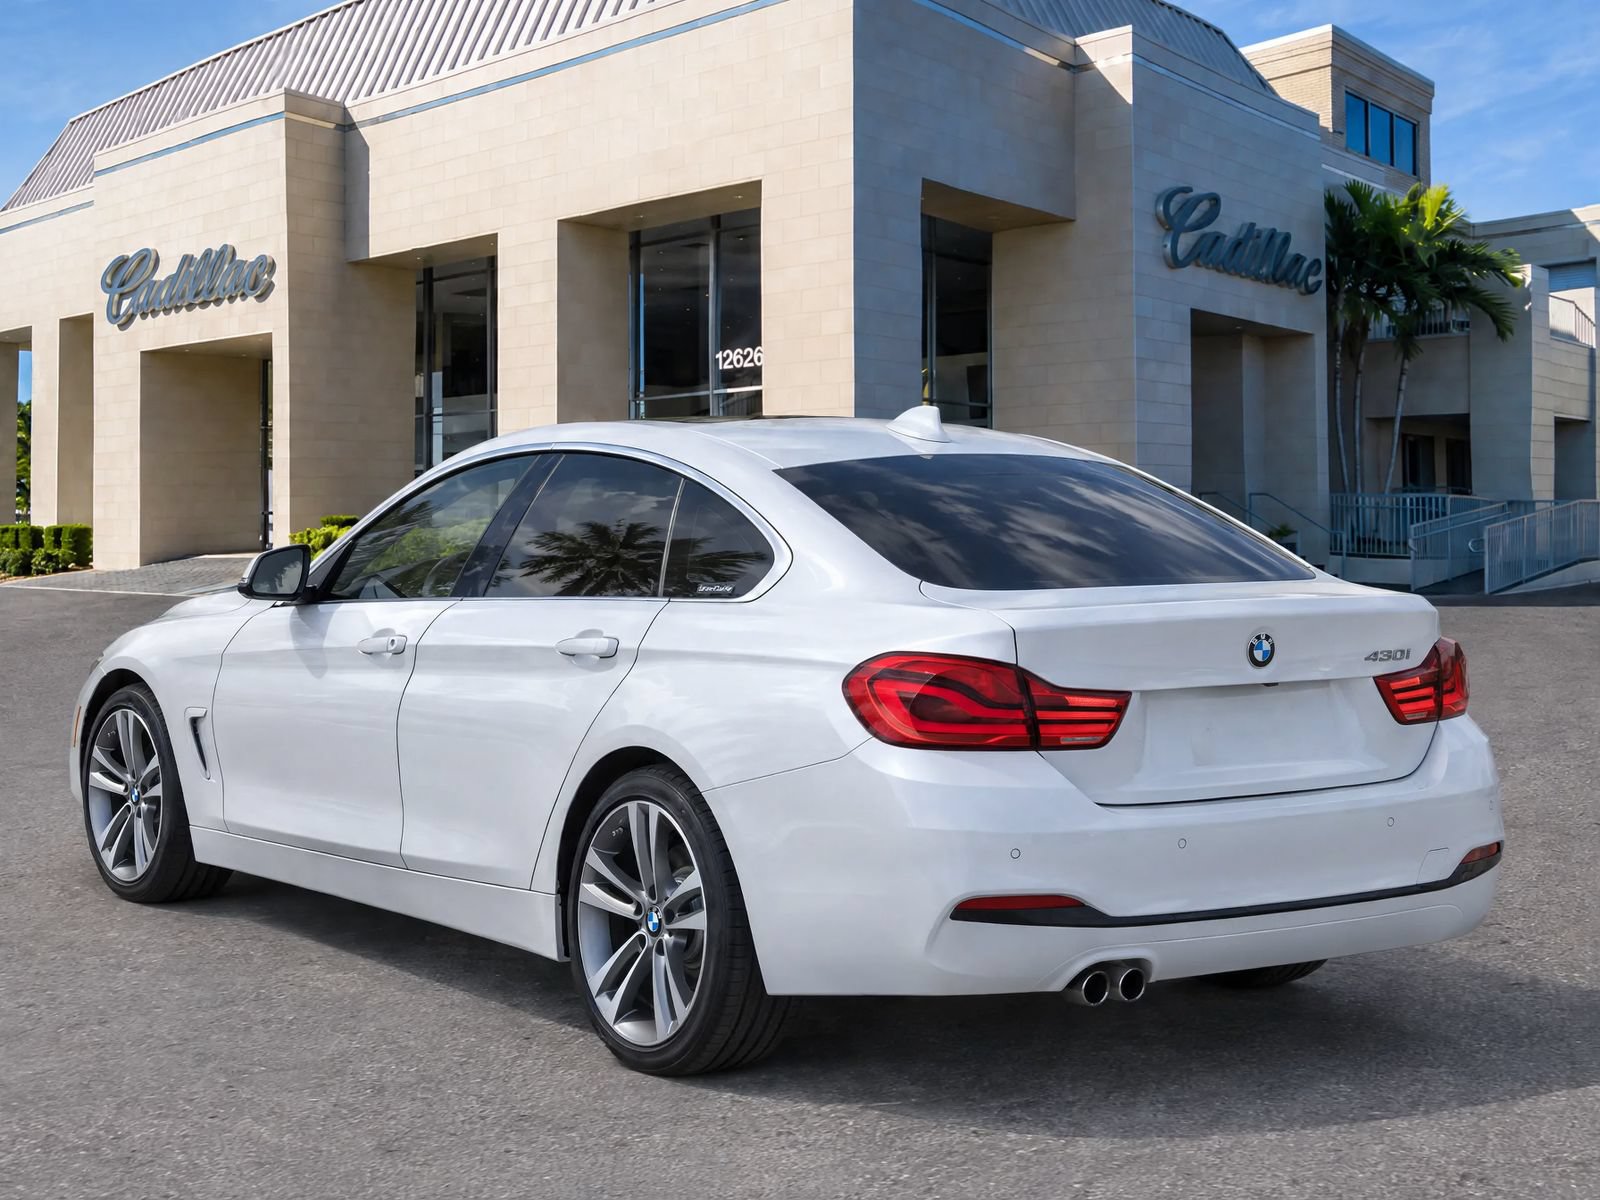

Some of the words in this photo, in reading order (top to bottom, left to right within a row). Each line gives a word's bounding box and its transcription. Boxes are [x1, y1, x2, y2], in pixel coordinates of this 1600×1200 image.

[1155, 186, 1323, 296] Cadillac
[100, 243, 276, 329] Cadillac
[715, 346, 763, 370] 12626
